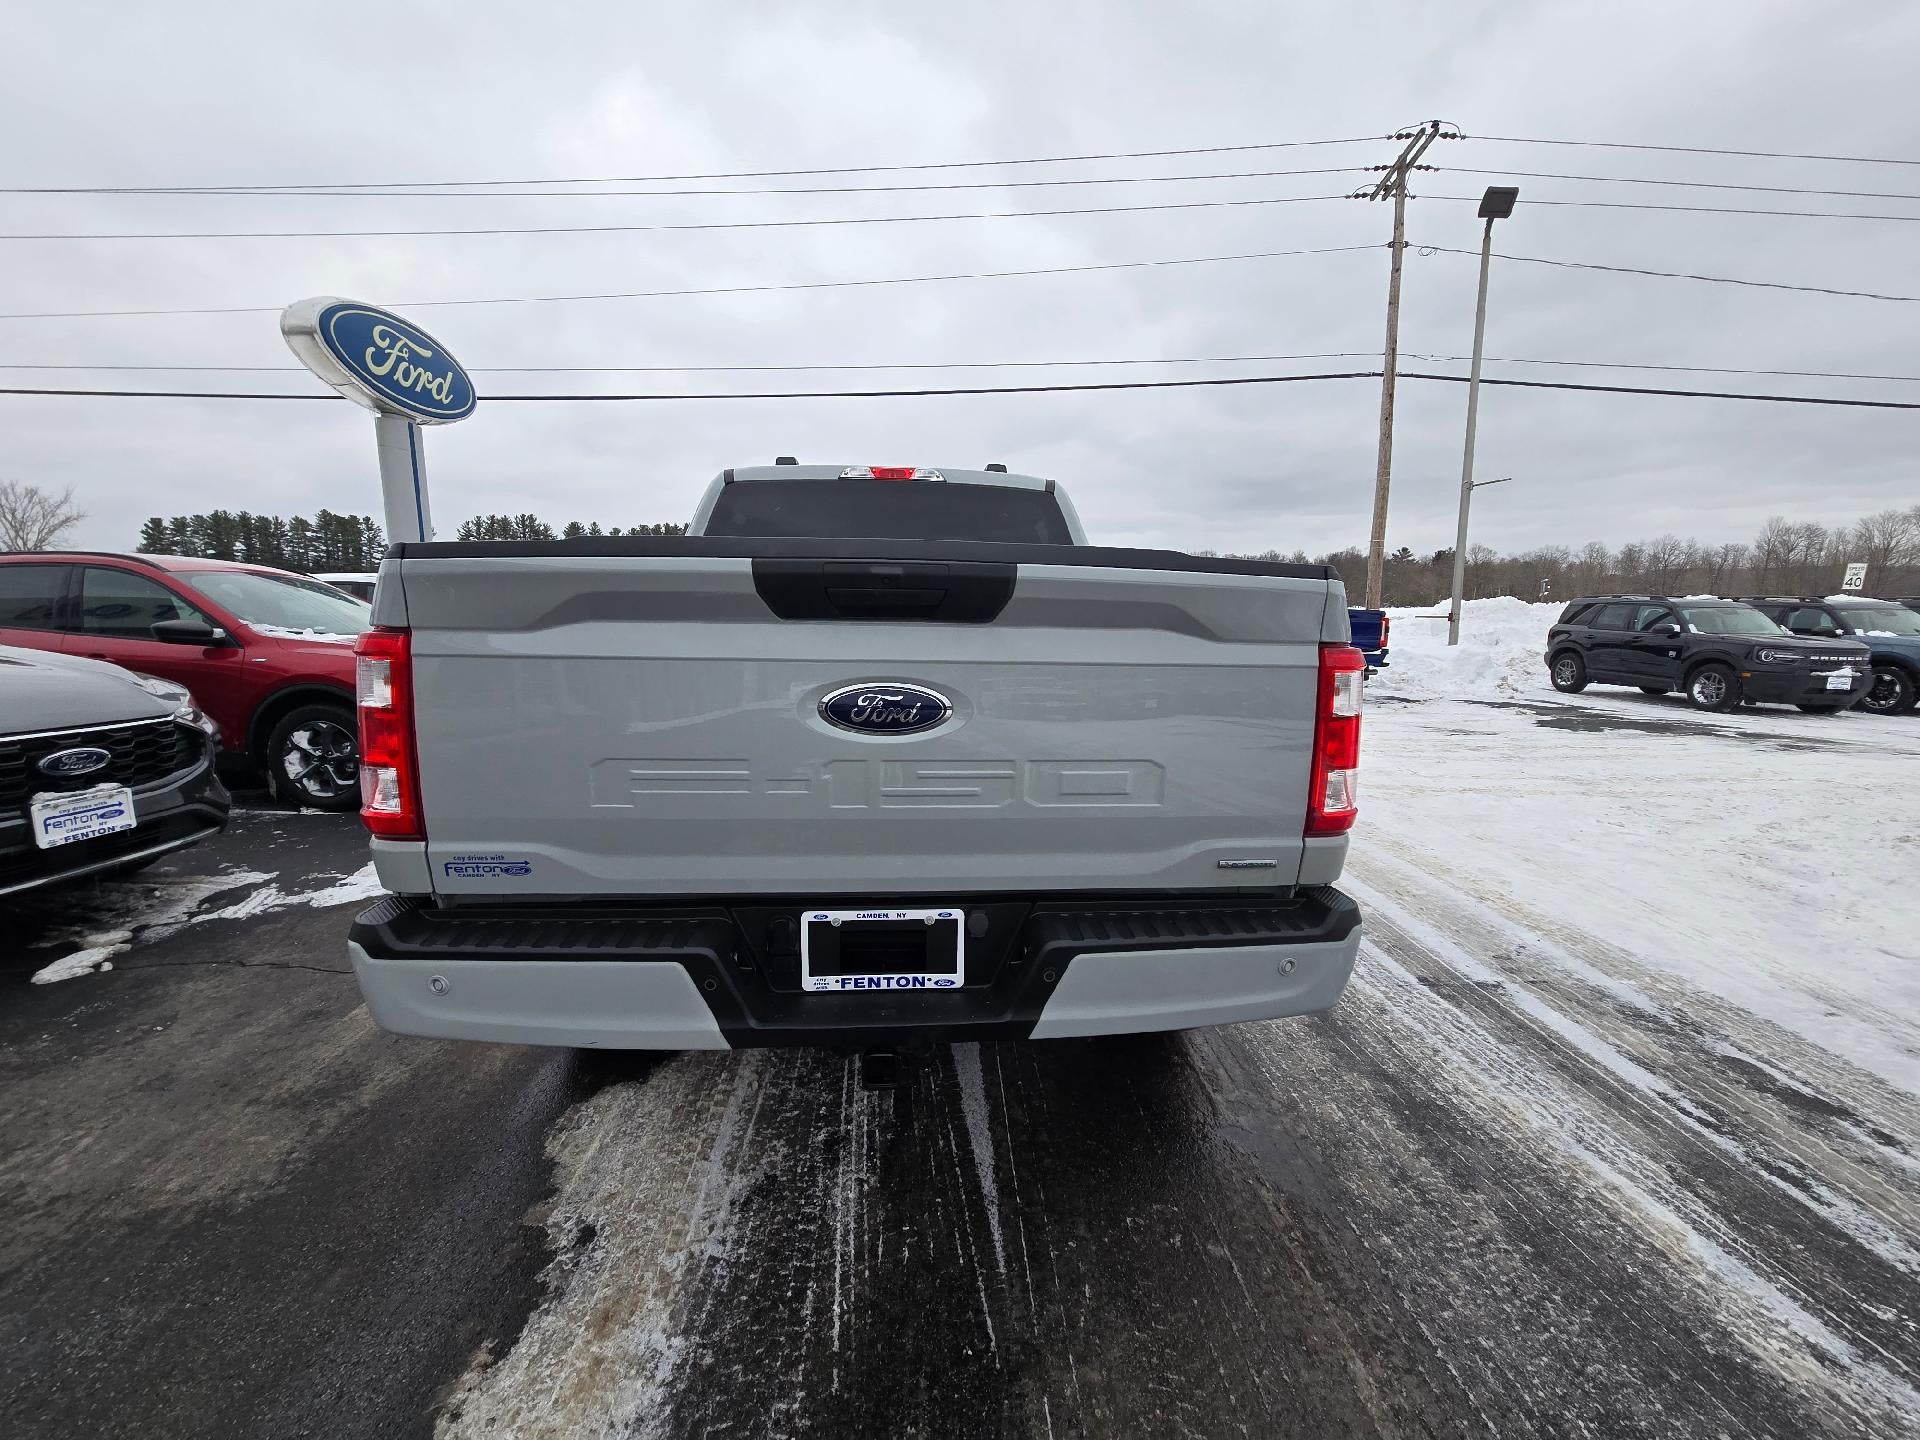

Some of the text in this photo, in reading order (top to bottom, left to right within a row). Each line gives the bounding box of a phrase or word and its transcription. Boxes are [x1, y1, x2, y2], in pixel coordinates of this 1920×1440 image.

[365, 325, 453, 404] Ford
[1845, 577, 1862, 587] 40
[851, 694, 922, 723] Ford
[60, 753, 97, 770] Ford
[64, 826, 116, 842] FENTON
[840, 976, 926, 989] FENTON
